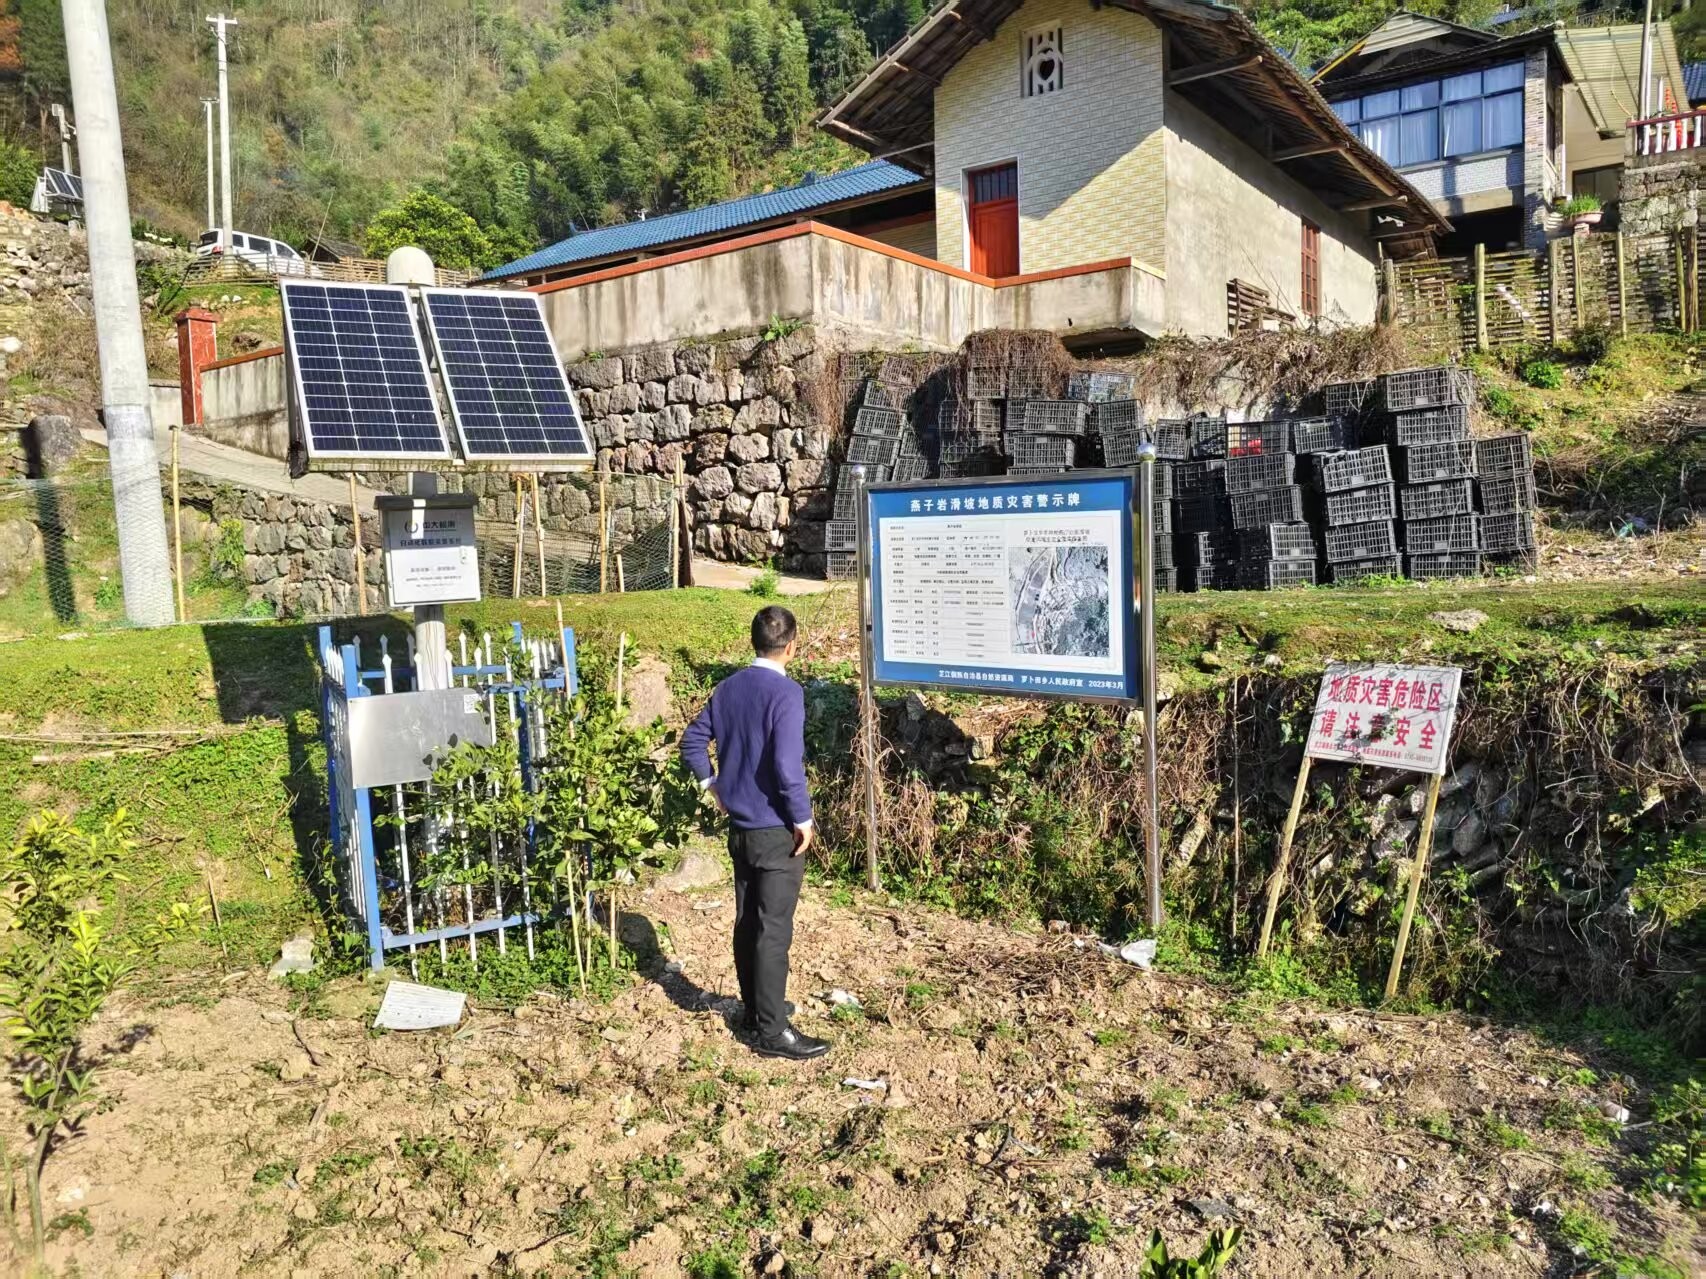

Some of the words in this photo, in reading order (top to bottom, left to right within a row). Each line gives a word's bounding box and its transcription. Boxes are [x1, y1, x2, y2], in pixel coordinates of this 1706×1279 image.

[910, 493, 1081, 512] 燕子岩滑坡地质灾害警示牌
[938, 669, 1014, 682] 芷江侗族自治县自然资源局
[1088, 679, 1123, 690] 2023年3月
[1328, 675, 1443, 712] 地质灾害危险区
[1320, 708, 1437, 750] 请注意安全
